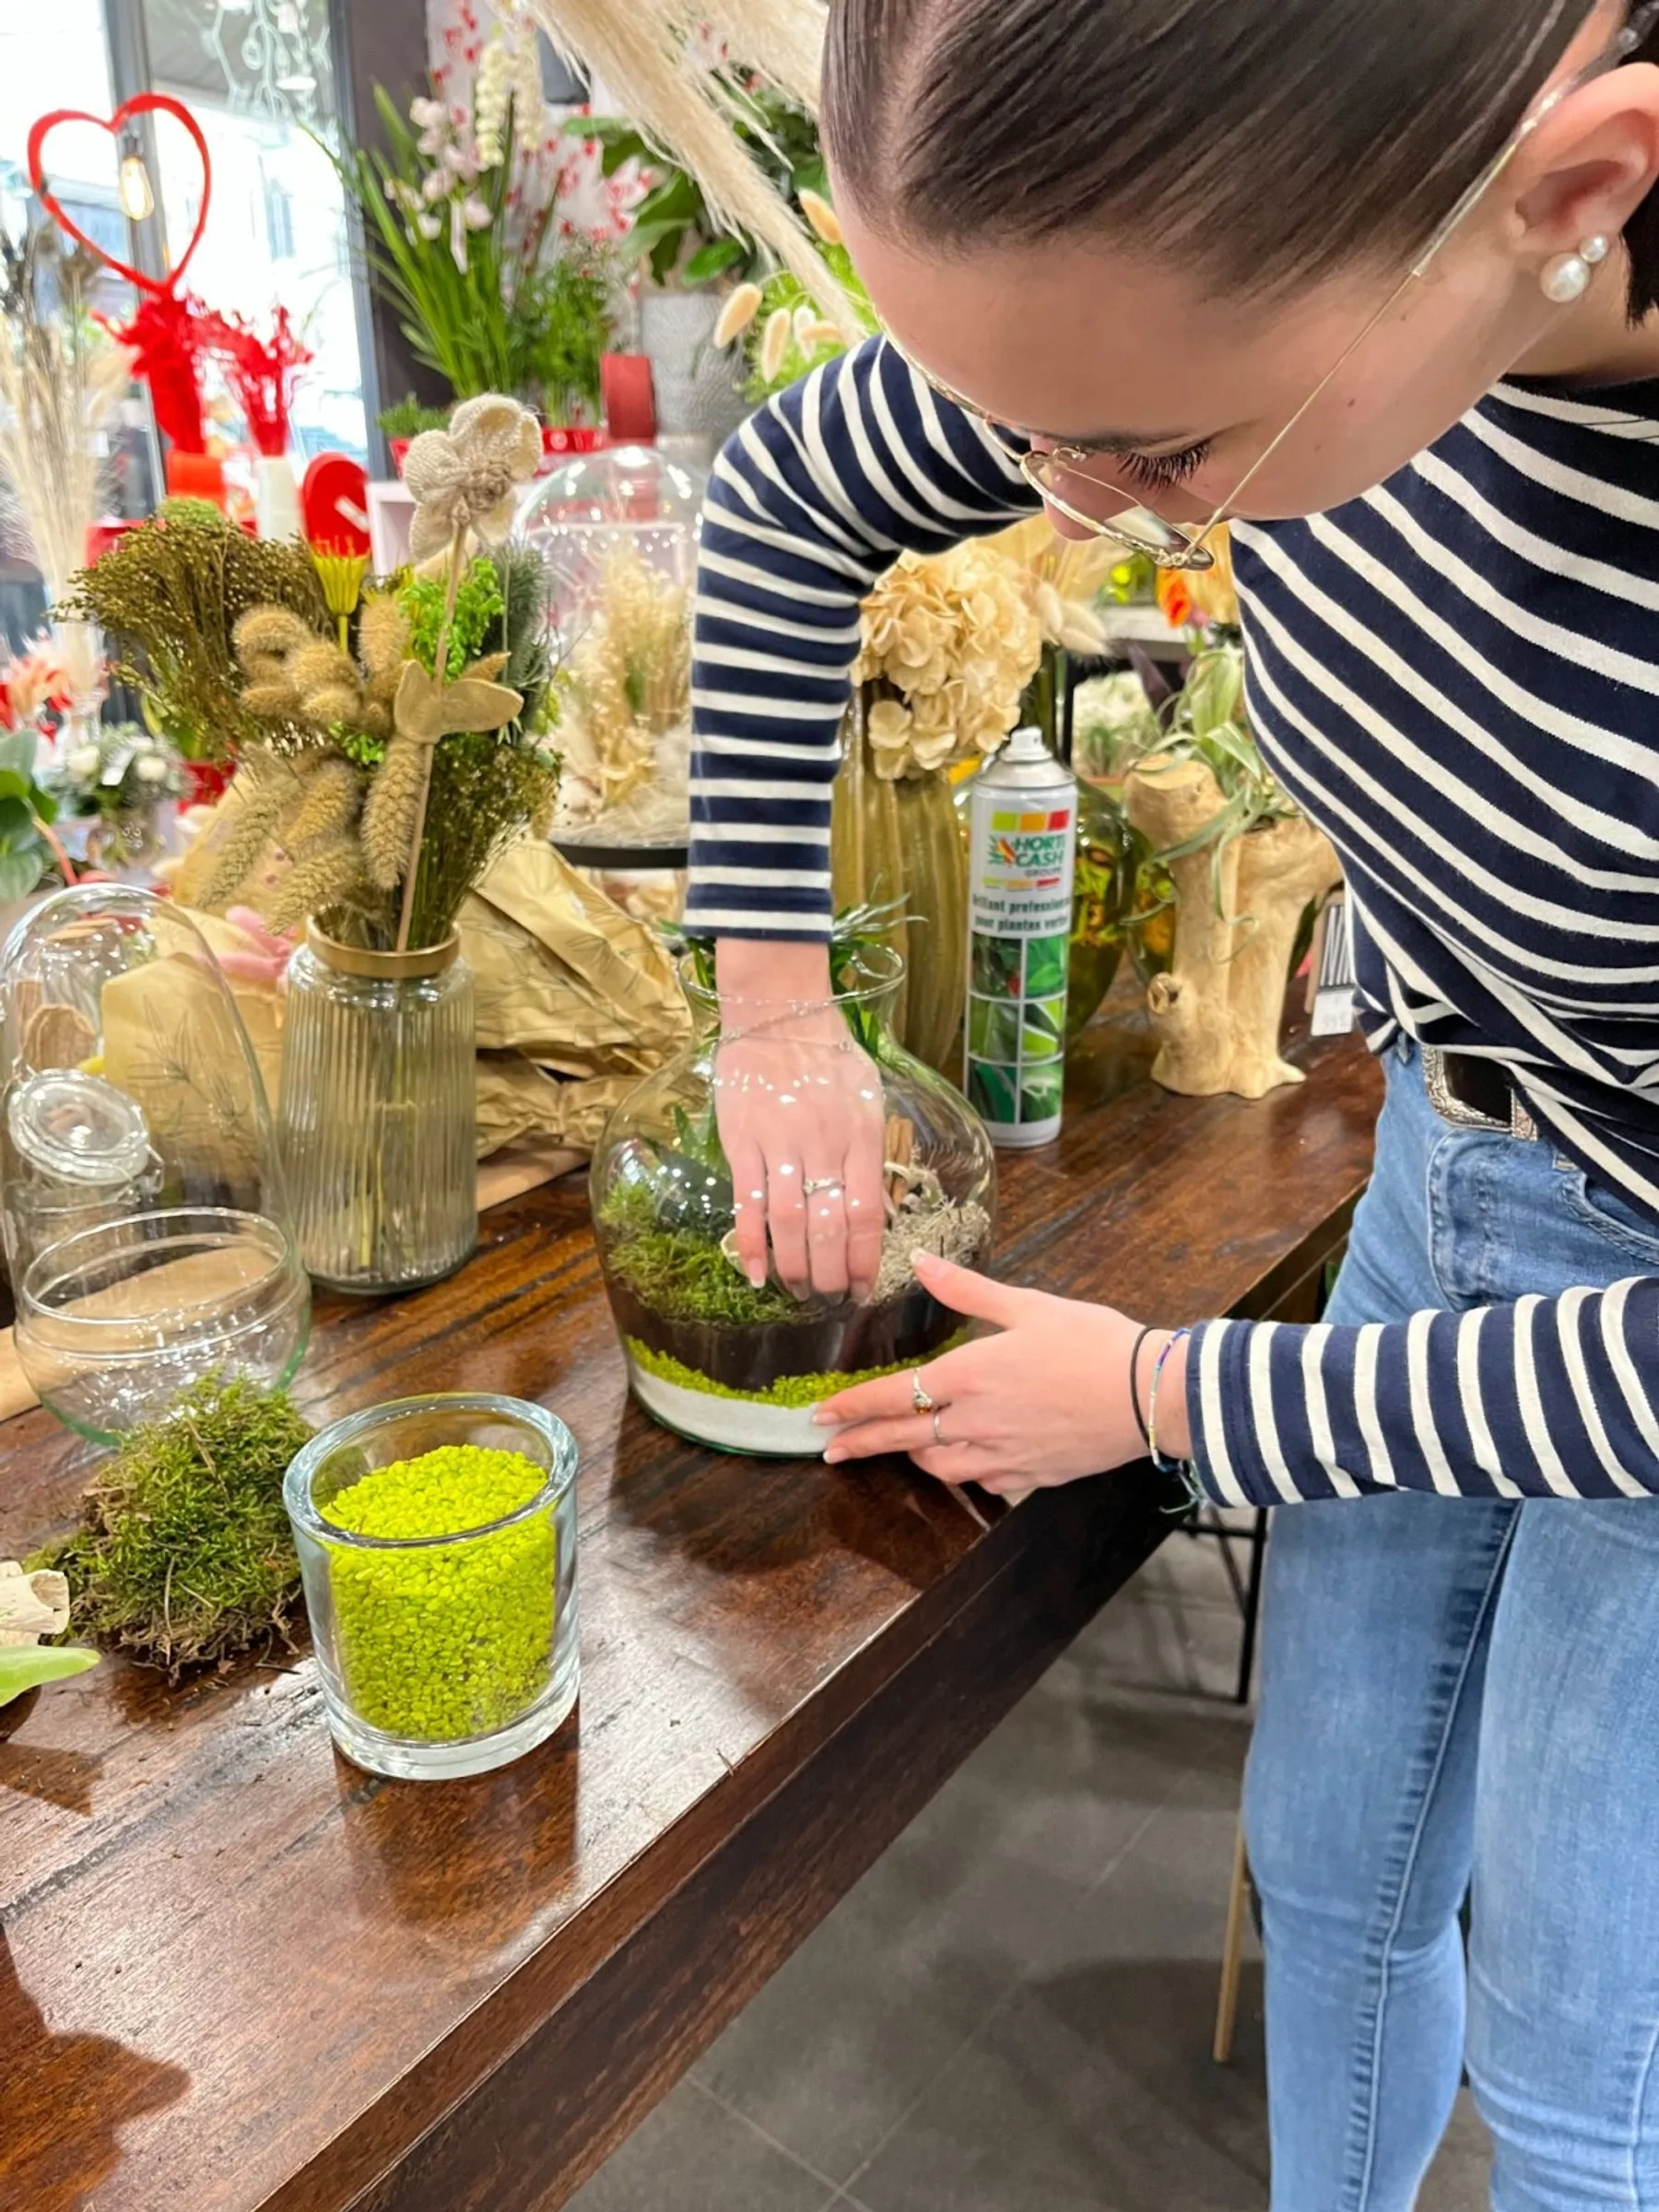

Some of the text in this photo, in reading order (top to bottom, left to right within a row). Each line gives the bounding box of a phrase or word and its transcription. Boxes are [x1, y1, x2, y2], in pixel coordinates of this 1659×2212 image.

[1013, 834, 1065, 852] HORTI
[1016, 851, 1063, 867] CASH
[998, 918, 1041, 932] plantes
